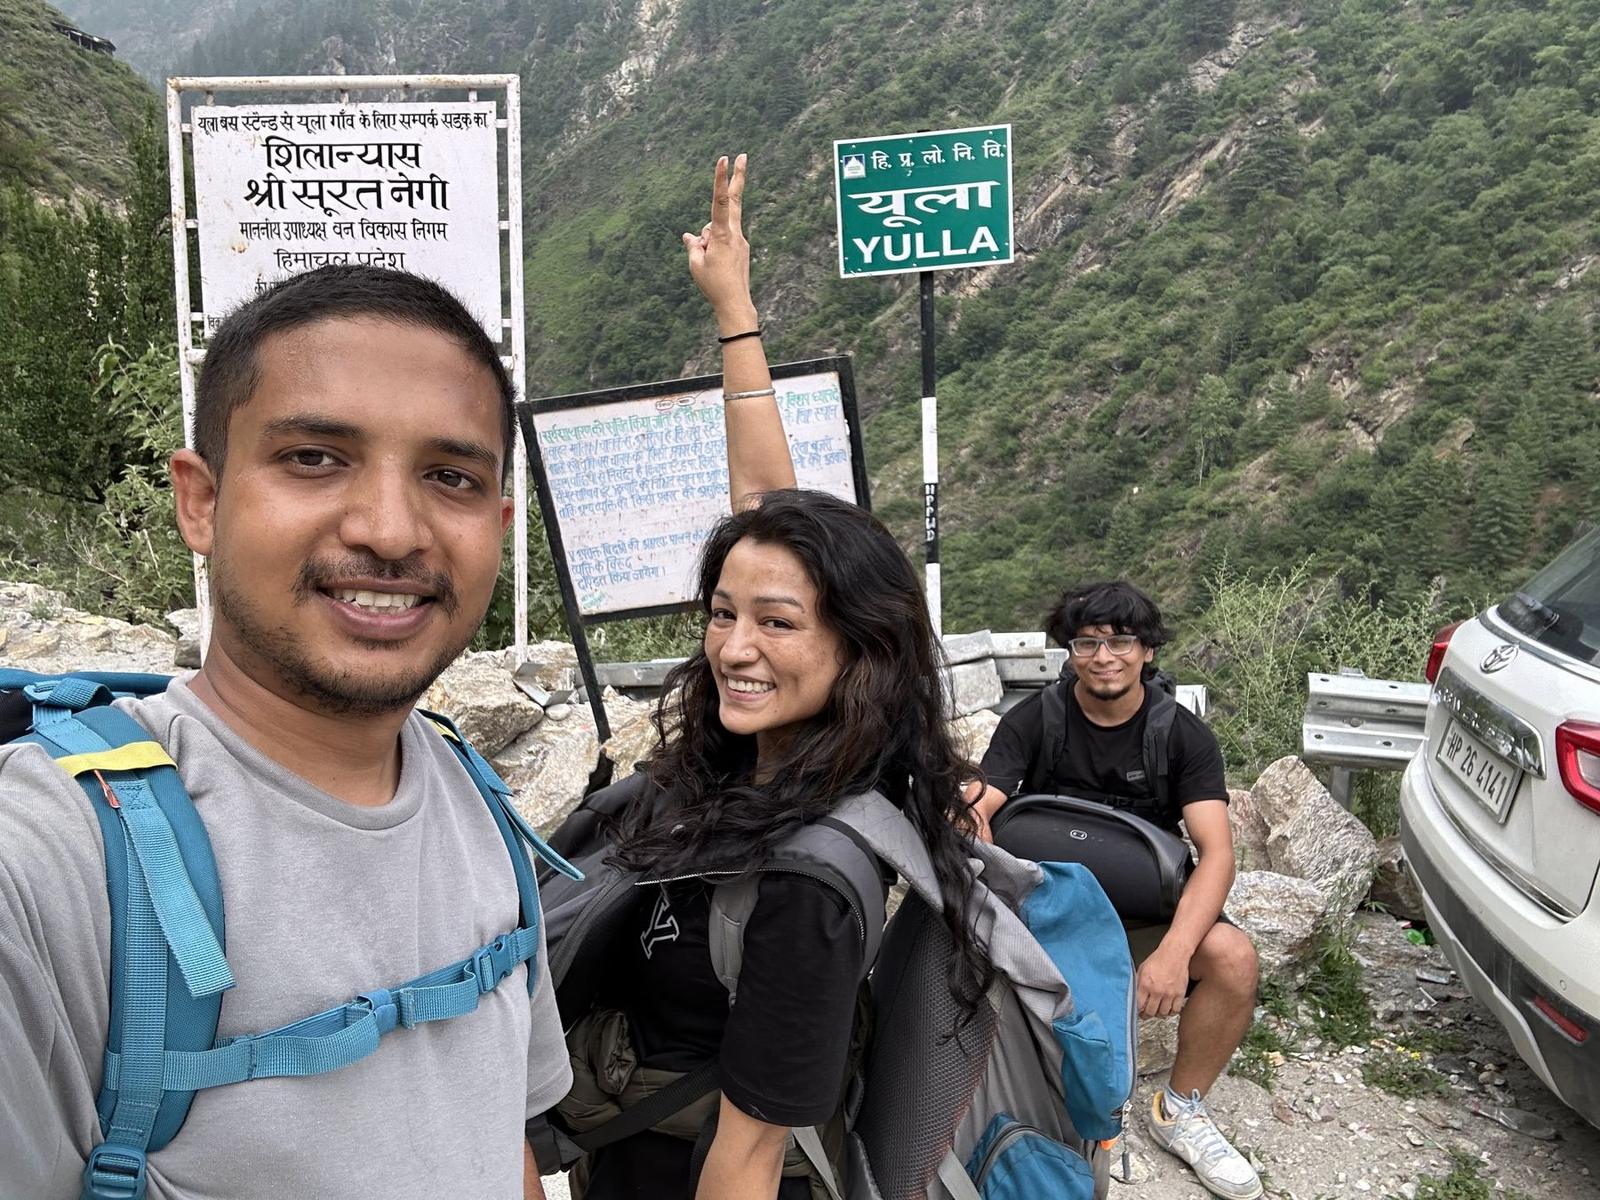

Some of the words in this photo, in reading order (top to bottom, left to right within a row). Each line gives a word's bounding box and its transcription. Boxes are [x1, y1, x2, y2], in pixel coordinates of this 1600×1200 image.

[198, 116, 218, 137] यूला
[220, 116, 239, 131] बस
[280, 111, 295, 131] से
[297, 115, 326, 134] यूला
[359, 110, 371, 128] के
[372, 110, 397, 131] लिए
[399, 109, 438, 130] सम्पर्क
[473, 112, 488, 128] का
[261, 136, 422, 173] शिलान्यास
[244, 172, 287, 210] श्री
[290, 179, 384, 217] सूरत
[387, 172, 450, 211] नेगी
[847, 181, 1001, 228] यूला
[239, 218, 281, 240] माननीय
[282, 221, 328, 241] उपाध्यक्ष
[333, 221, 355, 239] वन
[358, 217, 408, 240] विकास
[410, 217, 448, 241] निगम
[852, 226, 999, 264] YULLA
[1446, 732, 1463, 761] HP
[1460, 745, 1477, 776] 26
[1476, 760, 1507, 804] 4141
